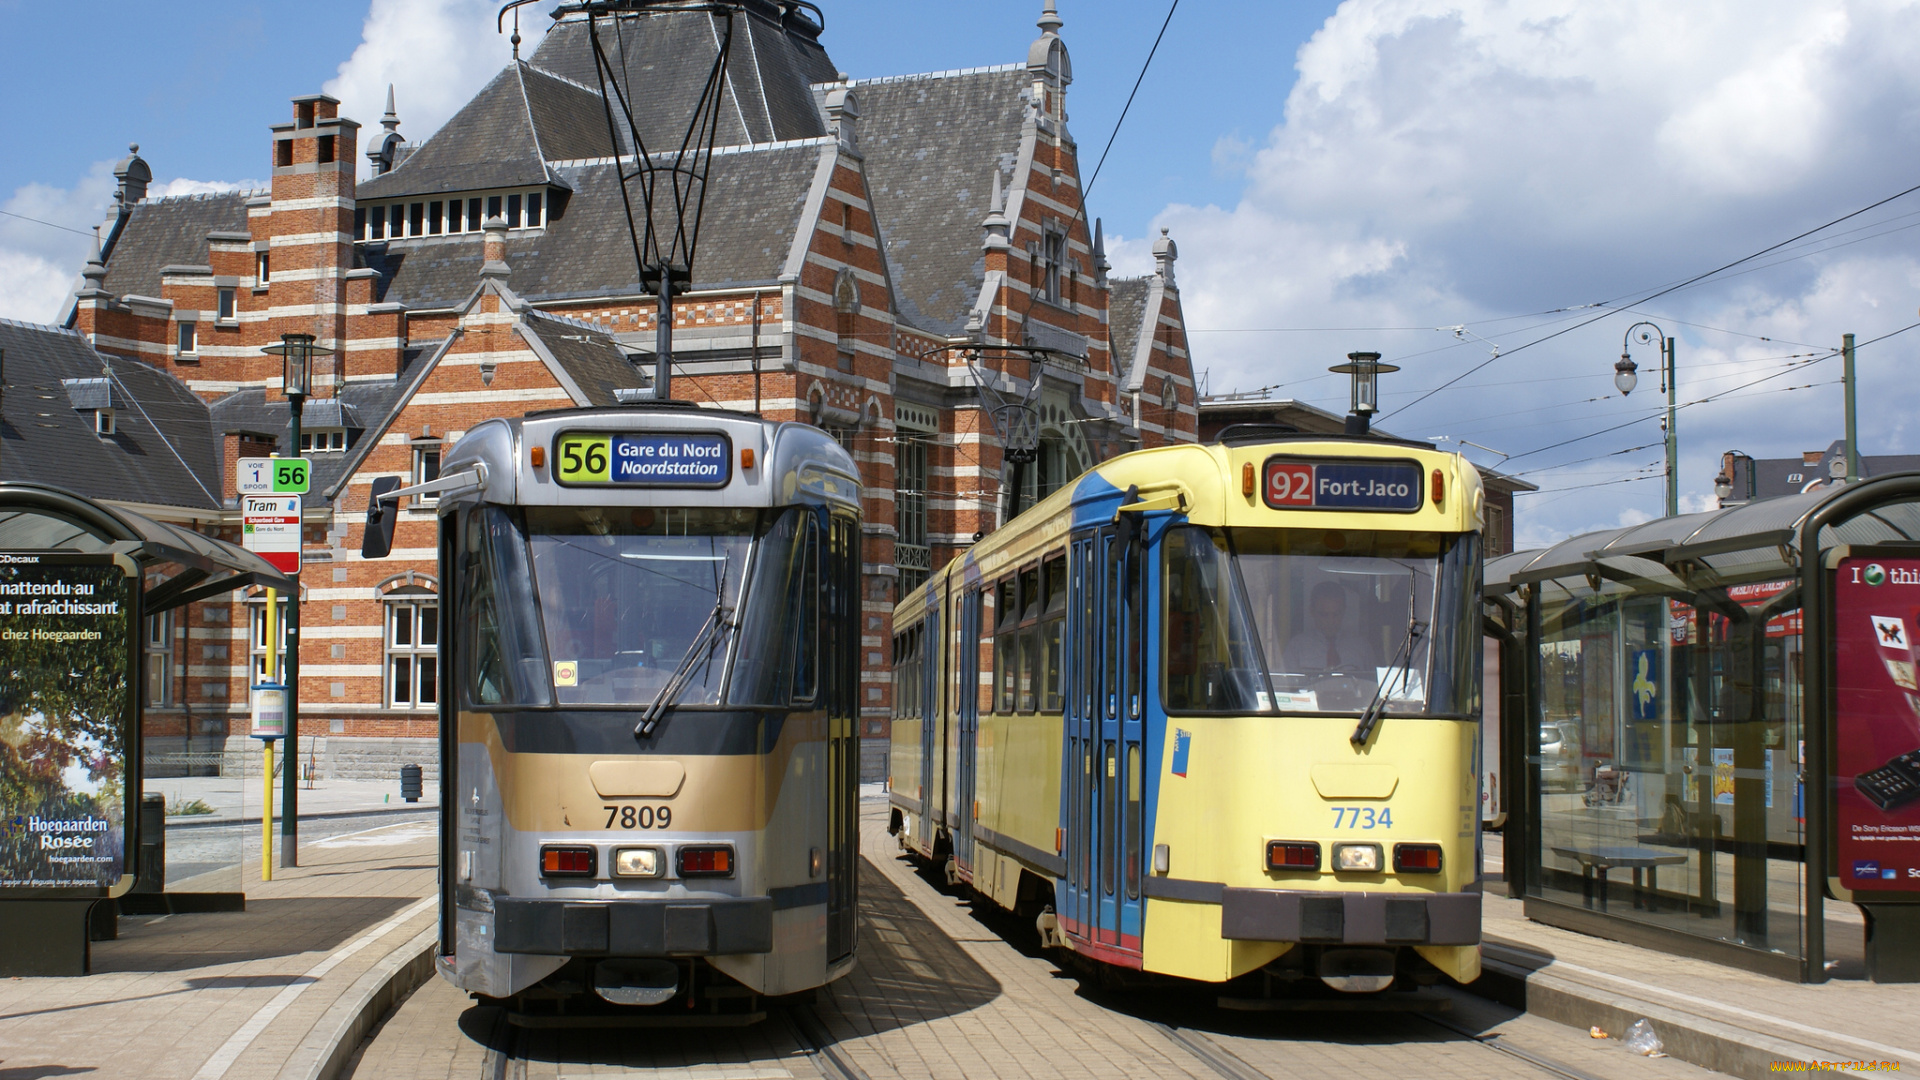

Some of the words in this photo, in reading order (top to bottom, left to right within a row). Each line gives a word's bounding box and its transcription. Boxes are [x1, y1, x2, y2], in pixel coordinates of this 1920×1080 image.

[563, 442, 607, 474] 56
[618, 442, 655, 457] Gare
[658, 442, 679, 457] du
[683, 443, 721, 458] Nord
[620, 460, 718, 475] Noordstation
[252, 470, 259, 482] 1
[278, 467, 305, 485] 56
[1272, 471, 1310, 500] 92
[1319, 478, 1409, 497] Fort-Jaco
[247, 499, 277, 511] Tram
[245, 524, 254, 532] 56
[1851, 567, 1860, 583] I
[75, 584, 94, 595] au
[16, 599, 118, 614] rafraîchissant
[2, 629, 29, 640] chez
[32, 629, 102, 643] Hoegaarden
[28, 815, 108, 834] Hoegaarden
[603, 805, 672, 829] 7809
[1331, 807, 1393, 829] 7734
[1863, 825, 1879, 833] Sony
[40, 834, 93, 850] Rosée
[48, 855, 114, 864] hoegaarden.com
